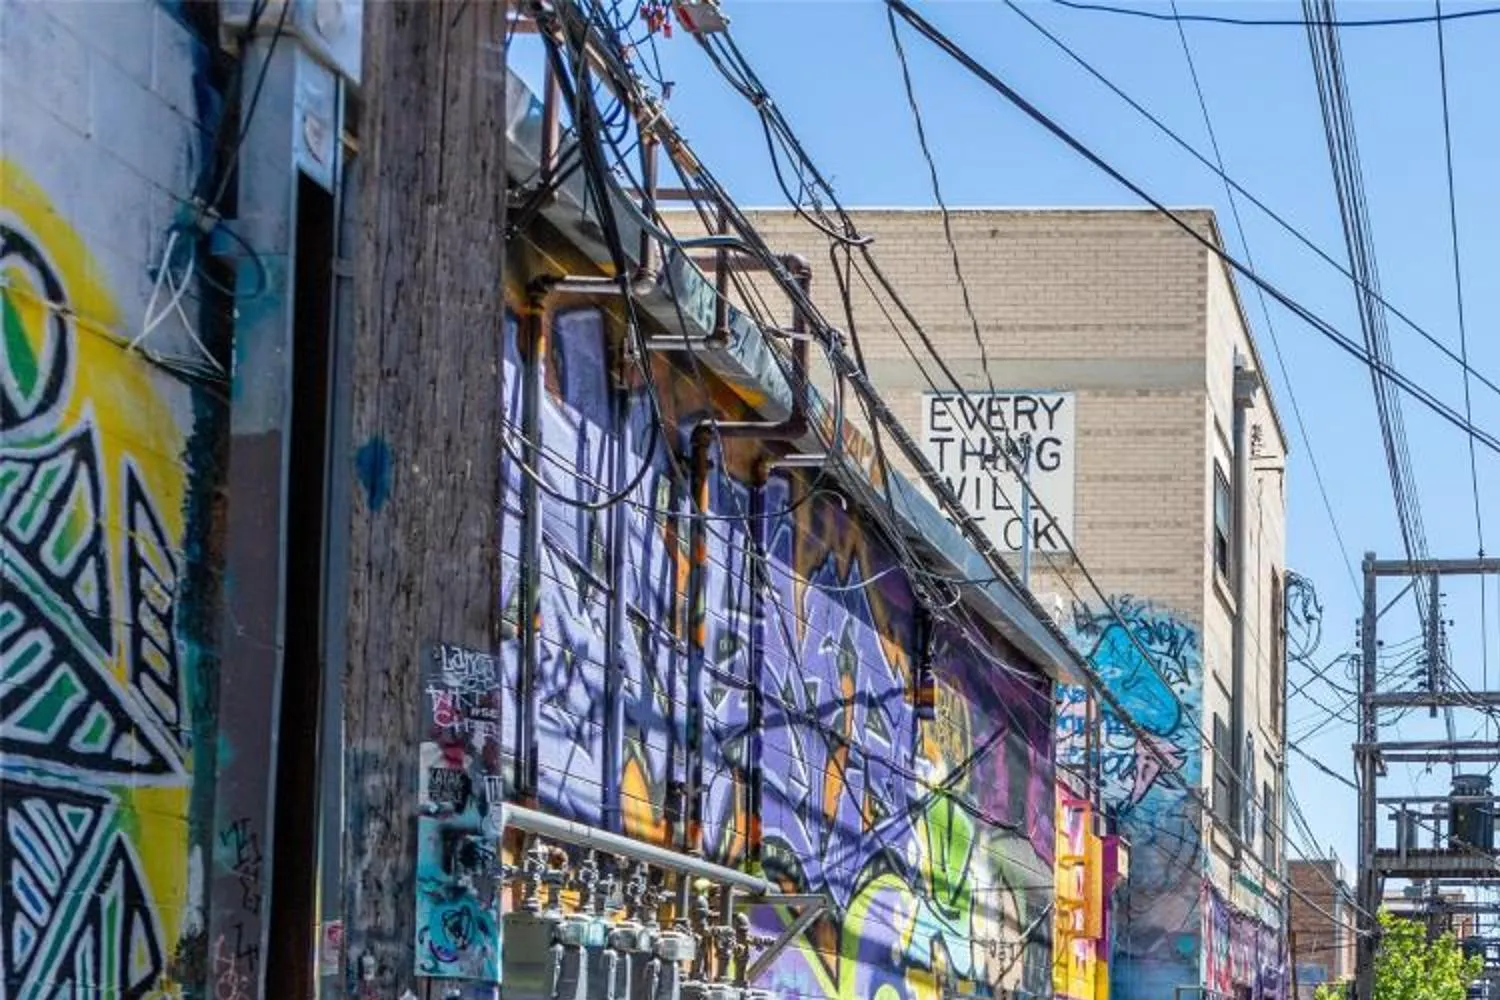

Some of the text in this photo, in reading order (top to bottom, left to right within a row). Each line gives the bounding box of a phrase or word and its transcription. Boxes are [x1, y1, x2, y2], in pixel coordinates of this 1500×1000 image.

[930, 396, 1065, 432] EVERY
[930, 436, 1063, 472] THING
[936, 476, 1044, 512] IL
